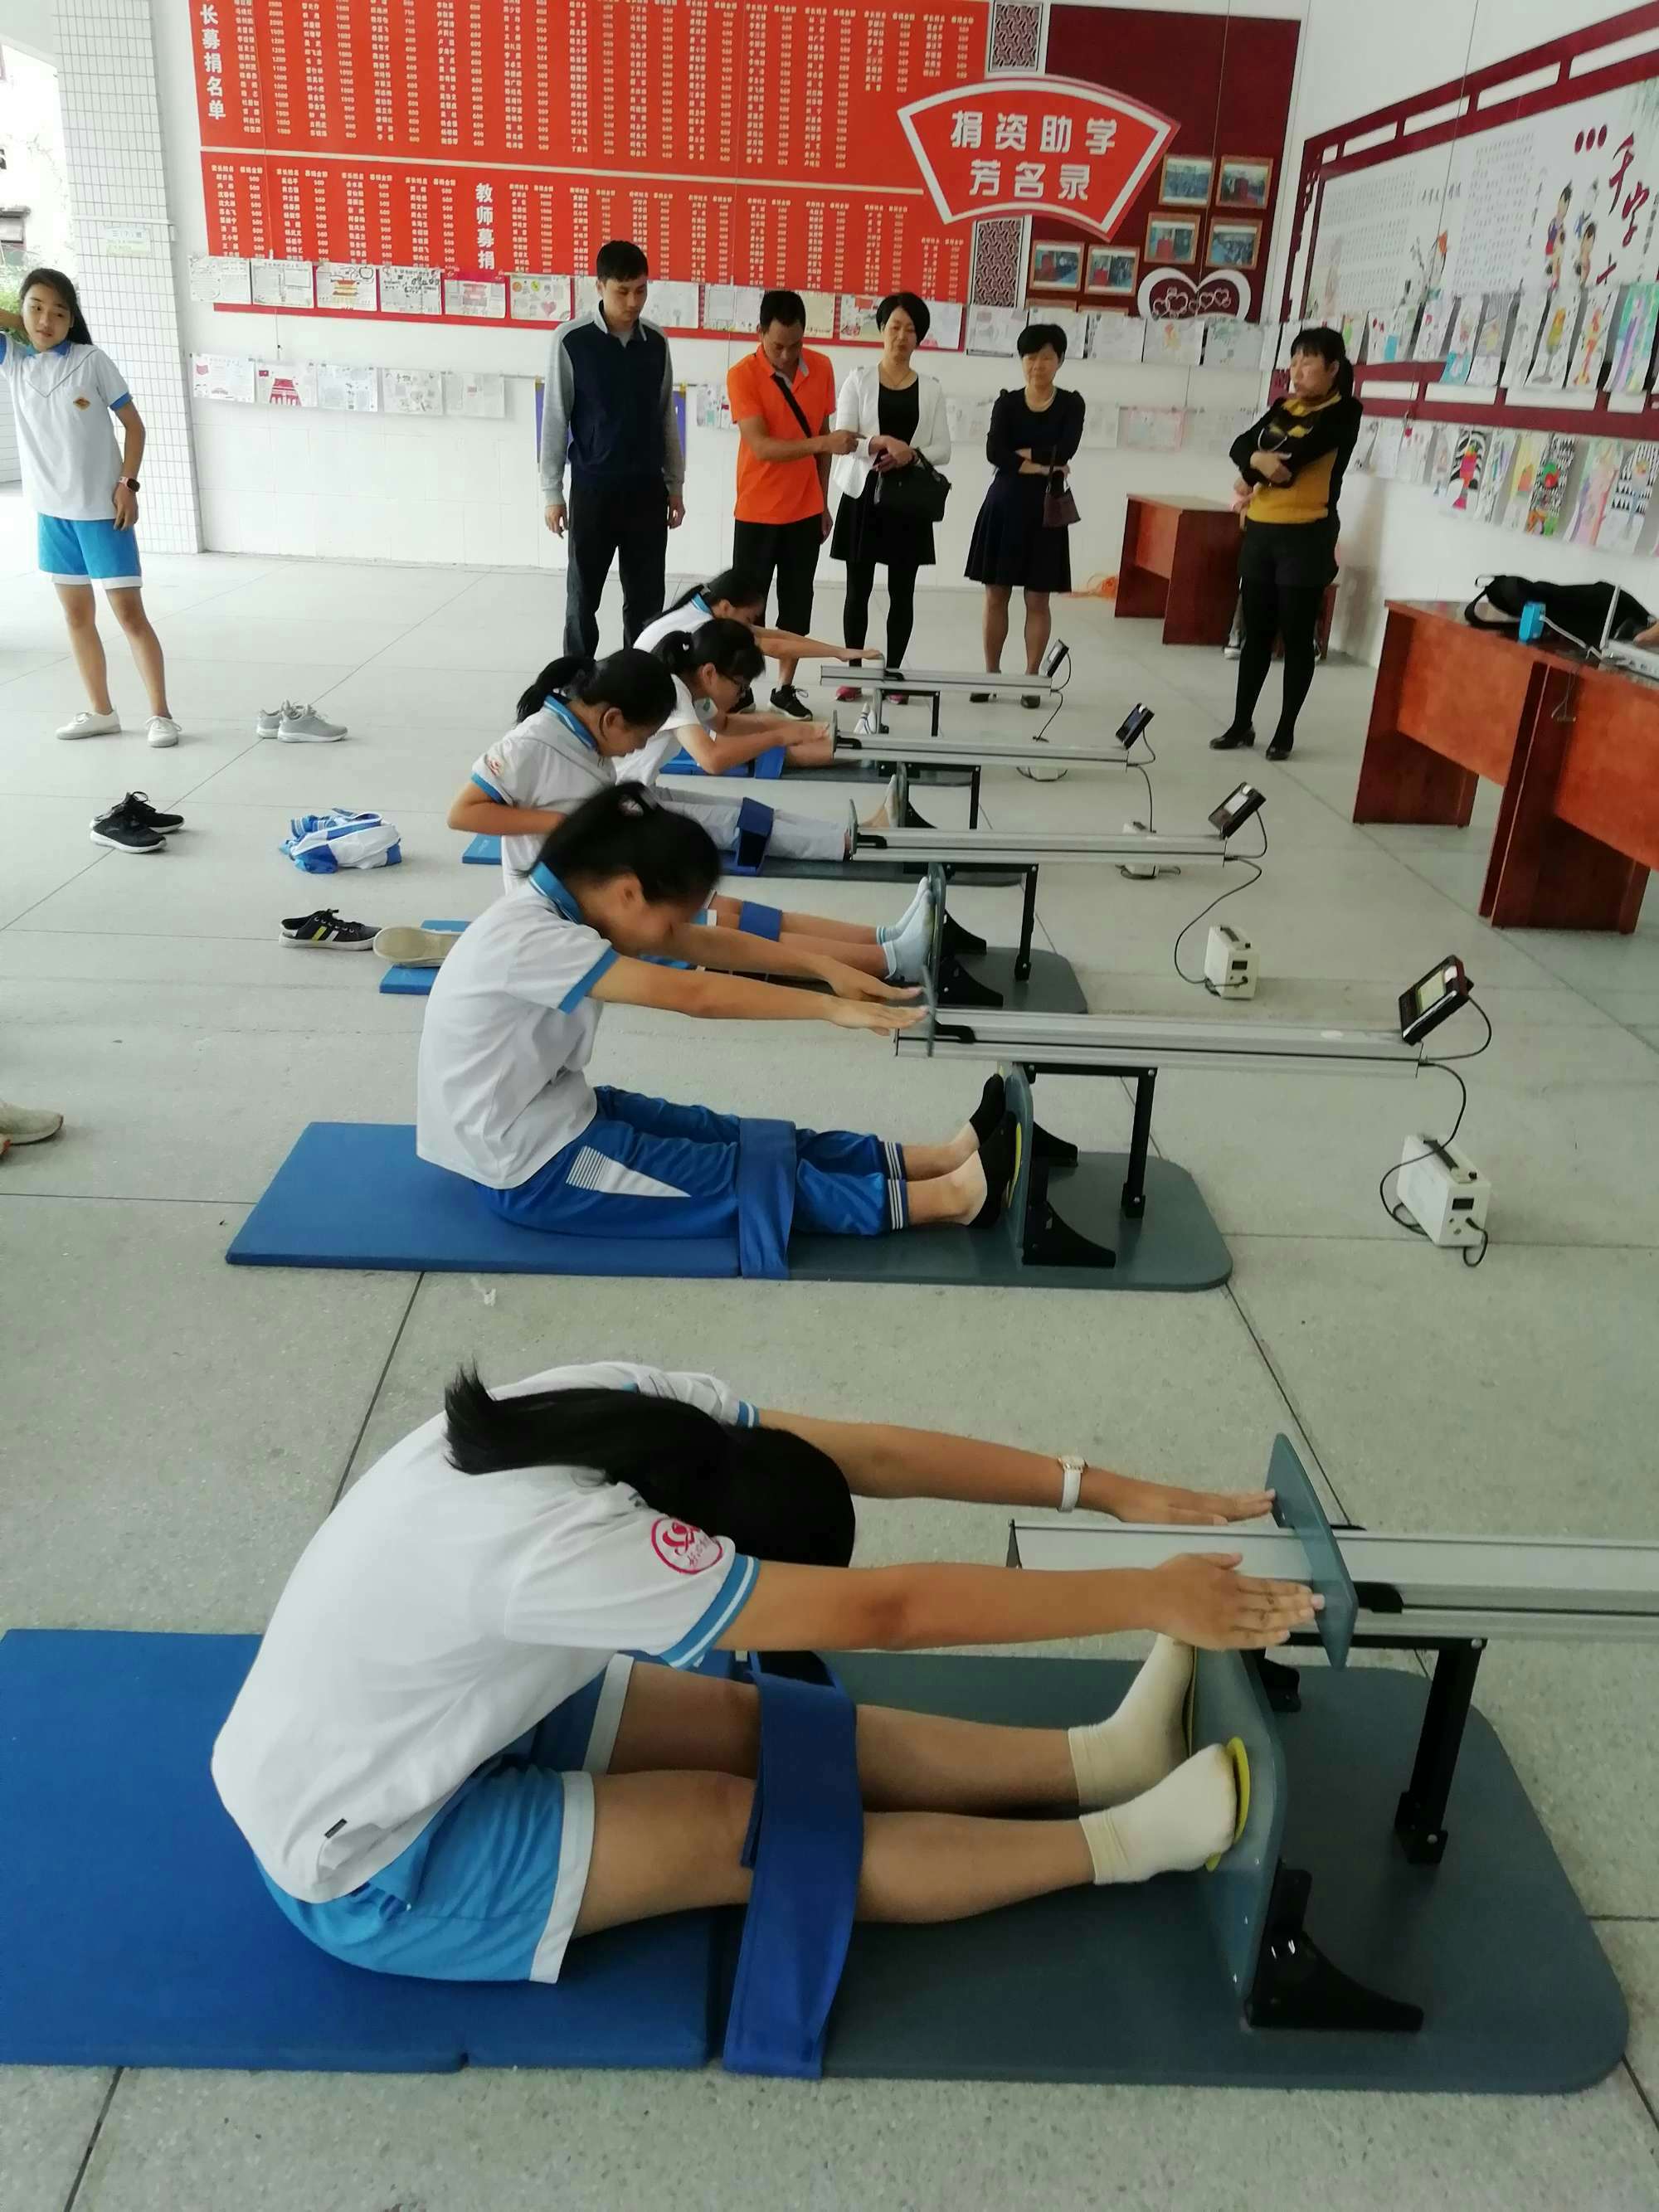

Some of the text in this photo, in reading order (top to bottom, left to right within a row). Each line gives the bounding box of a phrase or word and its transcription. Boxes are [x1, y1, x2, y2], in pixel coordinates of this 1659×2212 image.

[200, 3, 226, 120] 长募捐名单
[950, 109, 1118, 155] 捐资助学
[969, 159, 1091, 202] 芳名录
[475, 182, 495, 270] 教师募捐
